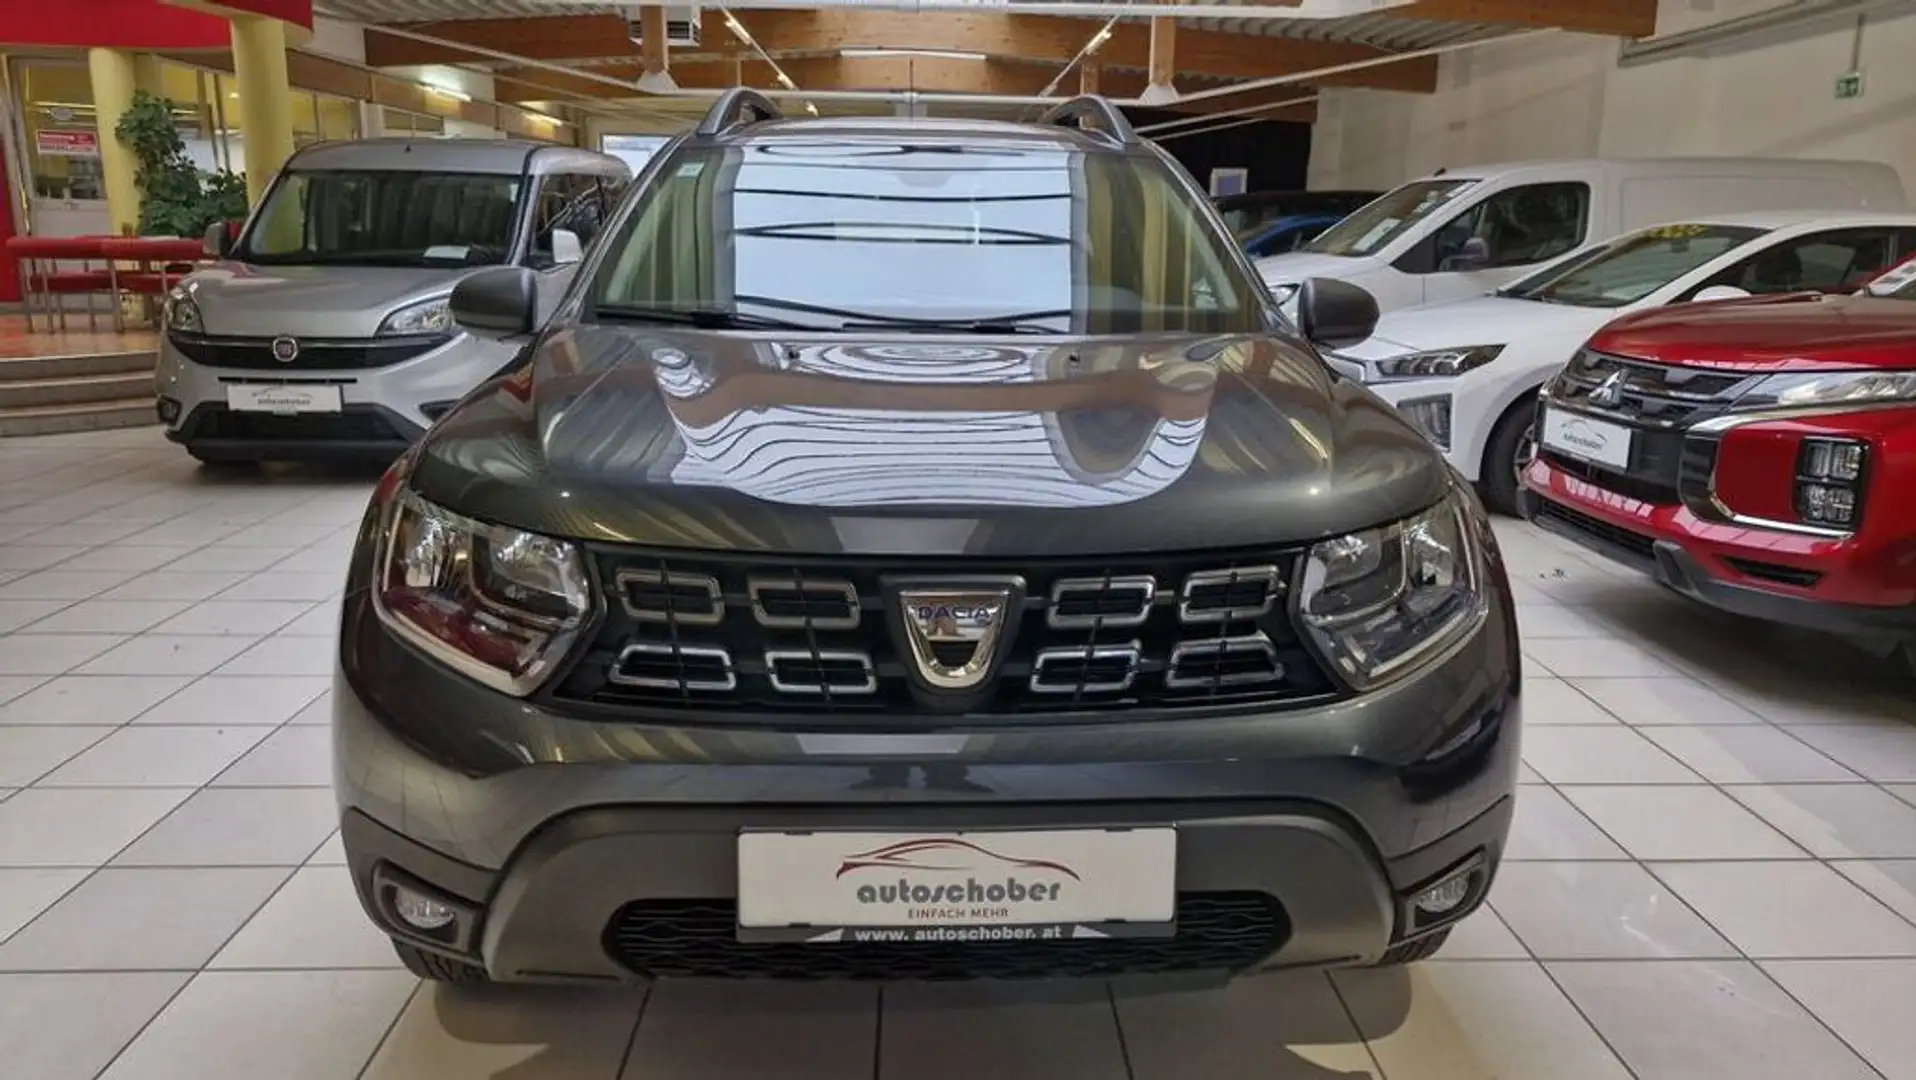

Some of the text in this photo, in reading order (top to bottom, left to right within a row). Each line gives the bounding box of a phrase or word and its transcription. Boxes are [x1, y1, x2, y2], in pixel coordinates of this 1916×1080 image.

[919, 606, 989, 619] DACIA
[856, 877, 1061, 904] autoschober
[907, 907, 1009, 920] EINFACH MEHR
